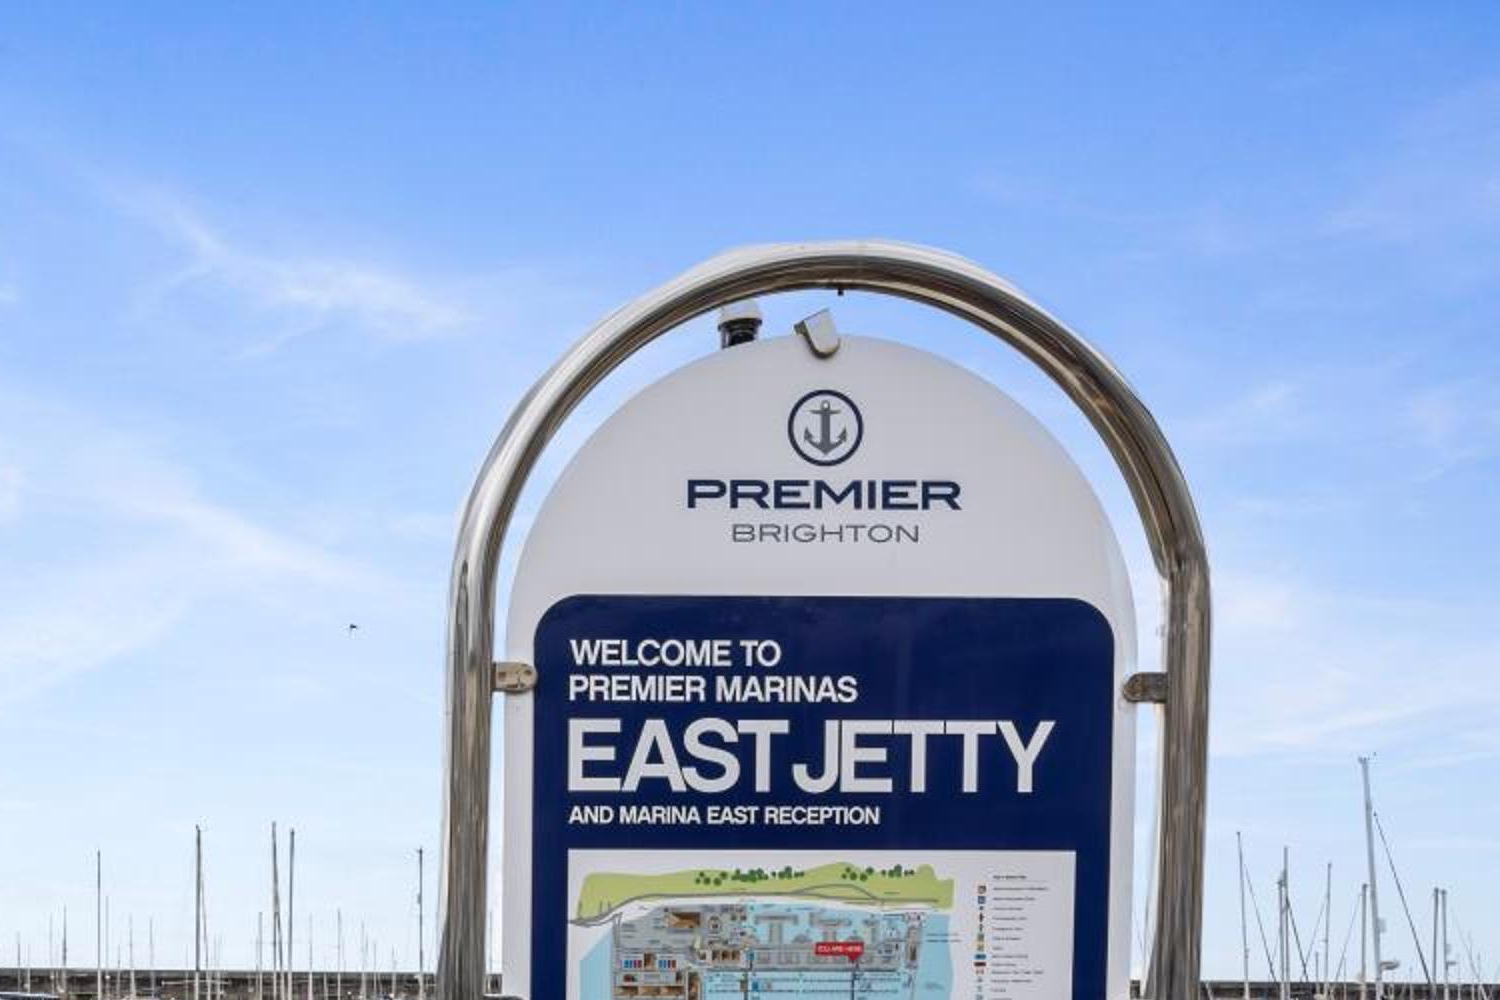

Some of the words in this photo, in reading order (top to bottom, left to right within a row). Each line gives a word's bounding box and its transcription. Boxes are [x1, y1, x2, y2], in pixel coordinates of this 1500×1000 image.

[686, 479, 962, 510] PREMIER
[731, 523, 919, 544] BRIGHTON
[570, 639, 731, 668] WELCOME
[739, 639, 781, 667] TO
[569, 675, 708, 703] PREMIER
[715, 675, 858, 702] MARINAS
[567, 720, 789, 792] EAST
[792, 719, 1056, 792] JETTY
[569, 807, 614, 825] AND
[619, 807, 701, 825] MARINA
[707, 807, 758, 824] EAST
[764, 806, 881, 824] RECEPTION
